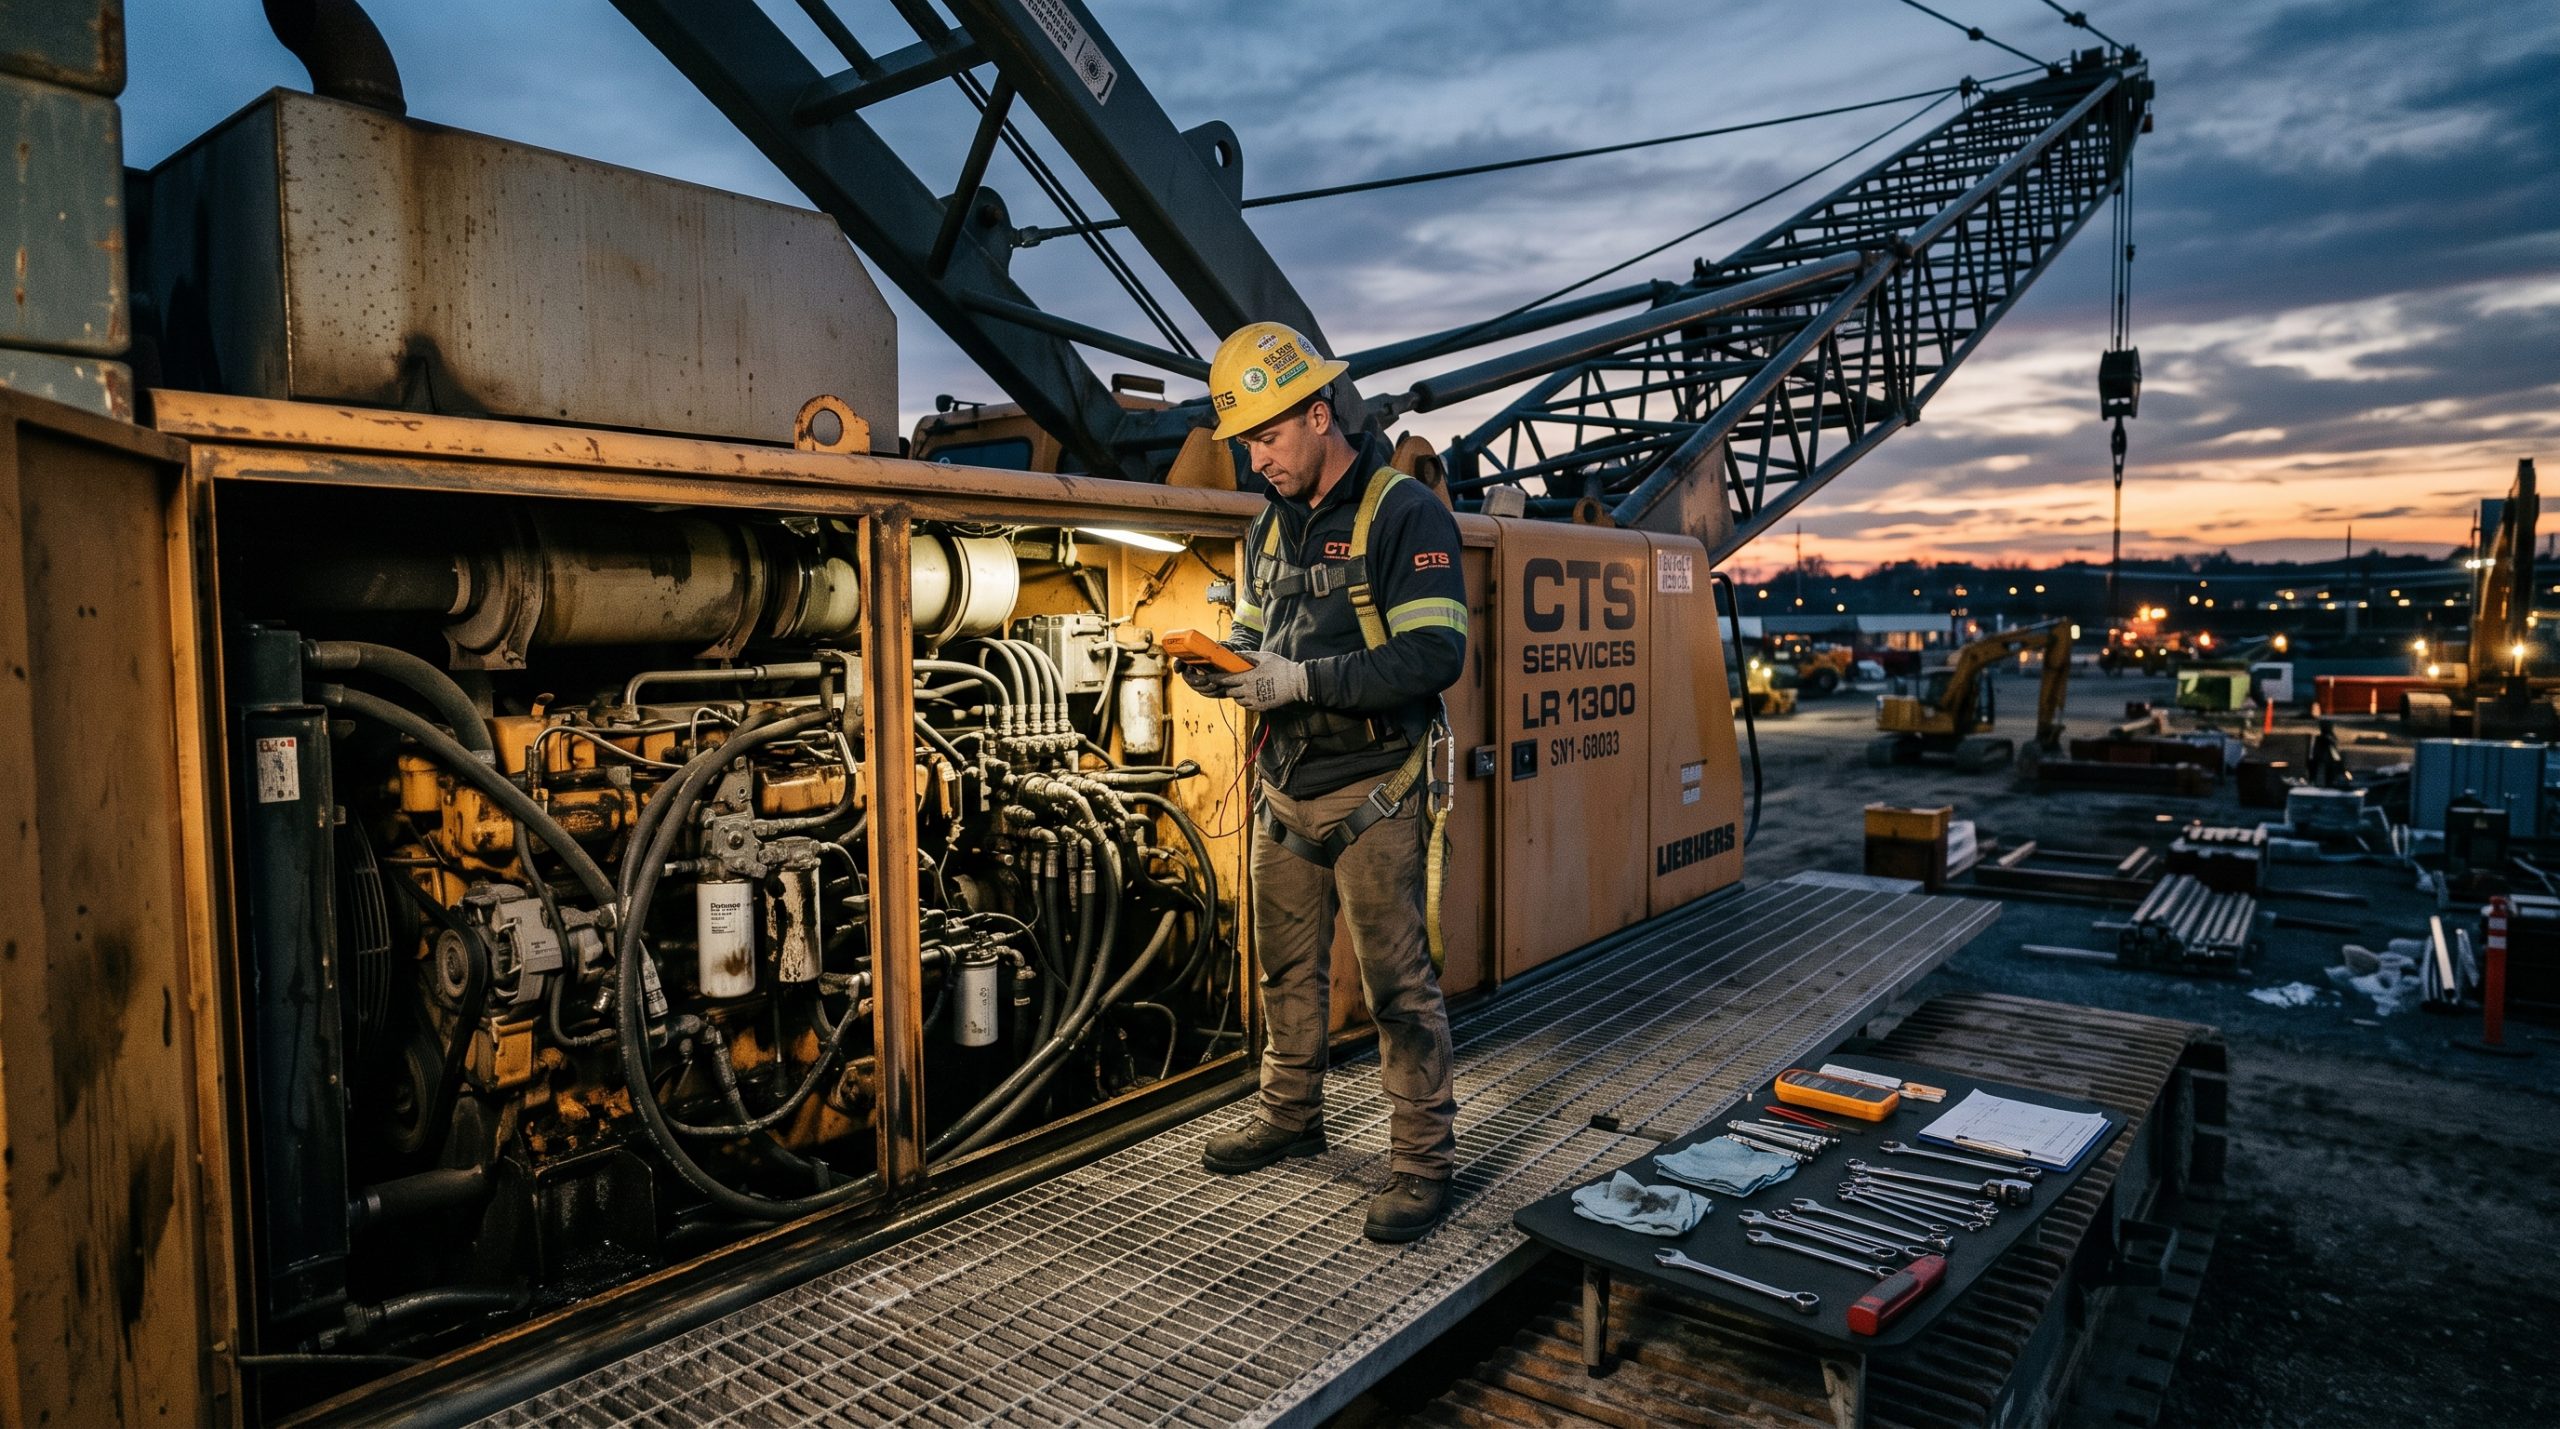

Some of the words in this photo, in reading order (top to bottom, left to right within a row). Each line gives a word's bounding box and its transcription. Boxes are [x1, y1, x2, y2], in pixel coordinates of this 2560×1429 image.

[1324, 542, 1351, 555] CT
[1414, 552, 1450, 566] CTS
[1523, 557, 1636, 632] CTS
[1523, 640, 1636, 674] SERVICES
[1523, 690, 1560, 729] LR
[1567, 682, 1635, 723] 1300
